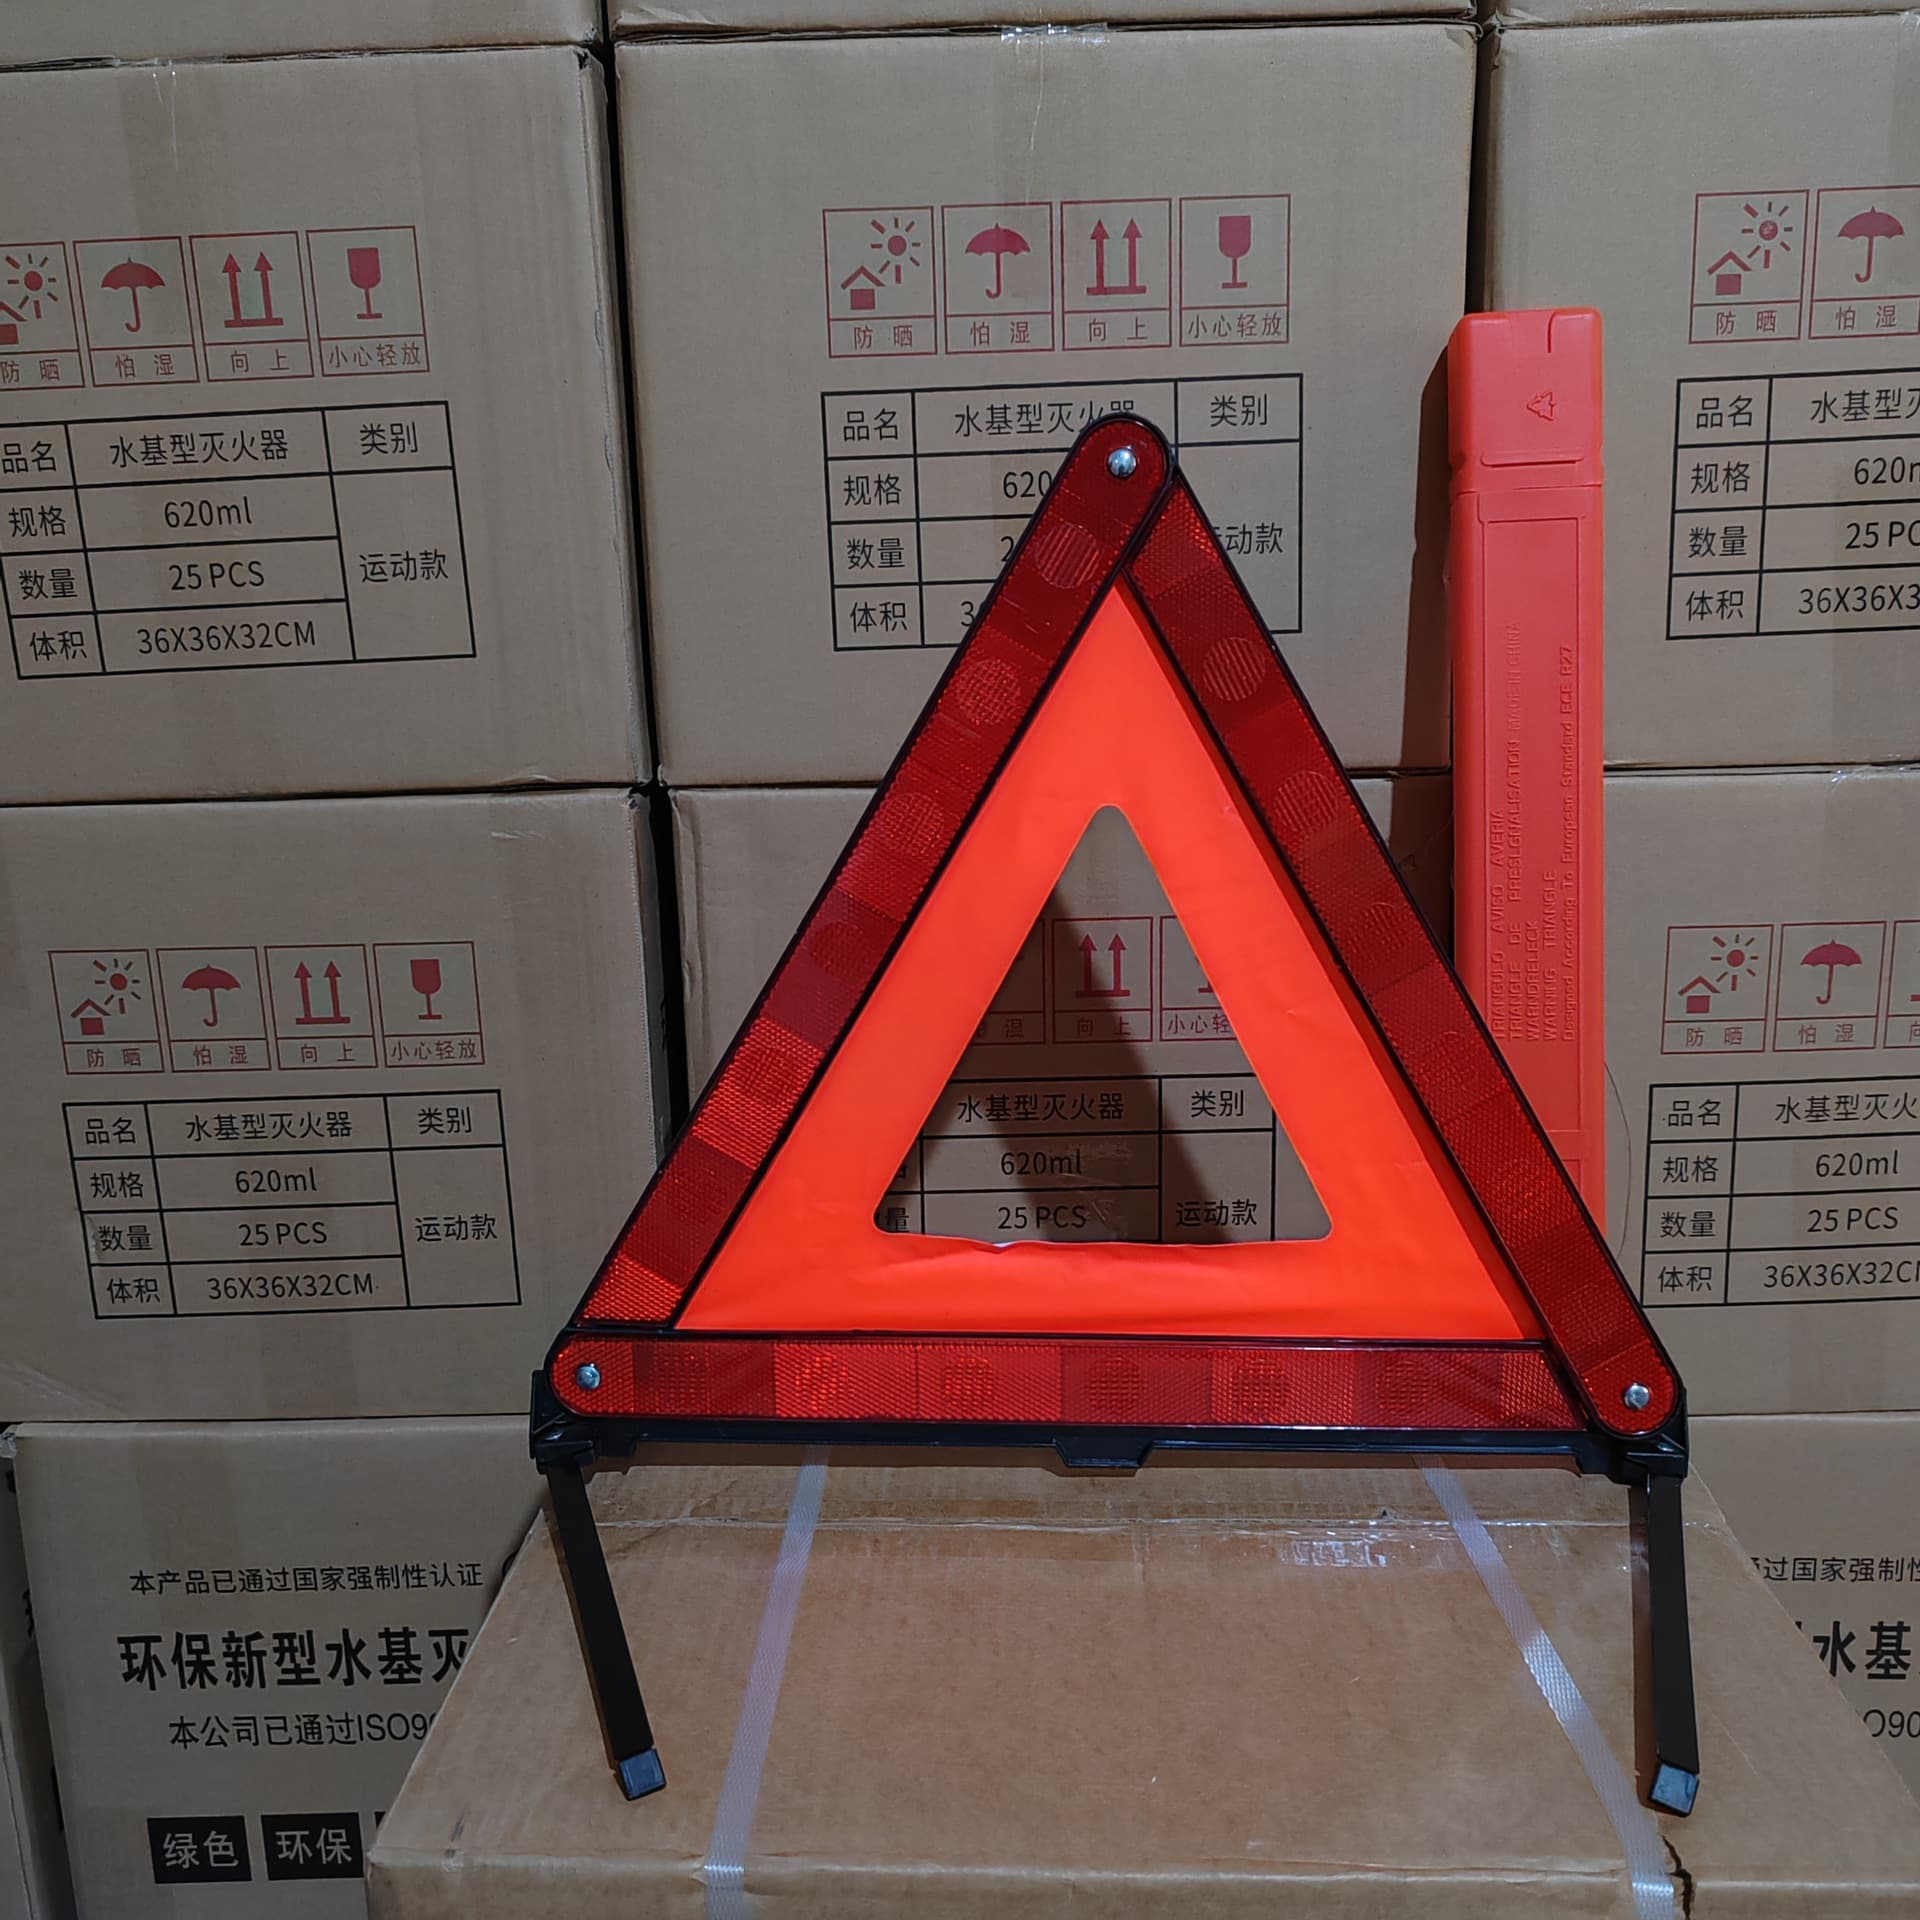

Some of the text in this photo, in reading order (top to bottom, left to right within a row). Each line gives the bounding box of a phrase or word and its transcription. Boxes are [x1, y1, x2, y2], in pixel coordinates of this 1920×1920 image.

[1187, 311, 1282, 339] 小心轻放
[329, 341, 425, 372] 小心轻放
[843, 408, 898, 442] 品名
[1210, 393, 1268, 428] 类别
[1696, 394, 1753, 430] 品名
[109, 429, 289, 469] 水基型灭火器
[359, 421, 418, 456] 类别
[1, 440, 57, 475] 品名
[843, 473, 902, 507] 规格
[1690, 460, 1751, 495] 规格
[8, 505, 66, 538] 规格
[164, 495, 253, 529] 620ml
[846, 537, 905, 570] 数量
[1688, 525, 1748, 559] 数量
[359, 548, 449, 583] 运动款
[18, 568, 79, 601] 数量
[849, 601, 908, 633] 体积
[1685, 589, 1744, 622] 体积
[29, 630, 88, 662] 体积
[136, 620, 316, 655] 36X36X32CM
[1560, 682, 1575, 715] ECE
[1507, 921, 1522, 945] DE
[1543, 870, 1558, 1041] WARNING TRIANGLE
[1507, 961, 1522, 1041] TRIANGLE
[391, 1038, 481, 1064] 小心轻放
[956, 1092, 1125, 1124] 水基型灭火器
[1191, 1089, 1244, 1118] 类别
[1667, 1098, 1721, 1127] 品名
[84, 1116, 136, 1145] 品名
[185, 1111, 353, 1142] 水基型灭火器
[417, 1106, 472, 1135] 类别
[999, 1149, 1083, 1177] 620ml
[1662, 1155, 1719, 1184] 规格
[1815, 1149, 1898, 1178] 620ml
[89, 1171, 144, 1199] 规格
[235, 1166, 318, 1194] 620ml
[415, 1213, 498, 1243] 运动款
[1176, 1199, 1258, 1228] 运动款
[1660, 1210, 1716, 1238] 数量
[98, 1224, 153, 1252] 数量
[206, 1272, 374, 1302] 36X36X32CM
[1657, 1265, 1713, 1293] 体积
[1763, 1260, 1920, 1288] 36X36X32C
[106, 1277, 161, 1305] 体积
[129, 1562, 484, 1596] 本产品已通过国家强制性认证
[162, 1829, 240, 1869] 绿色
[276, 1827, 353, 1865] 环保
